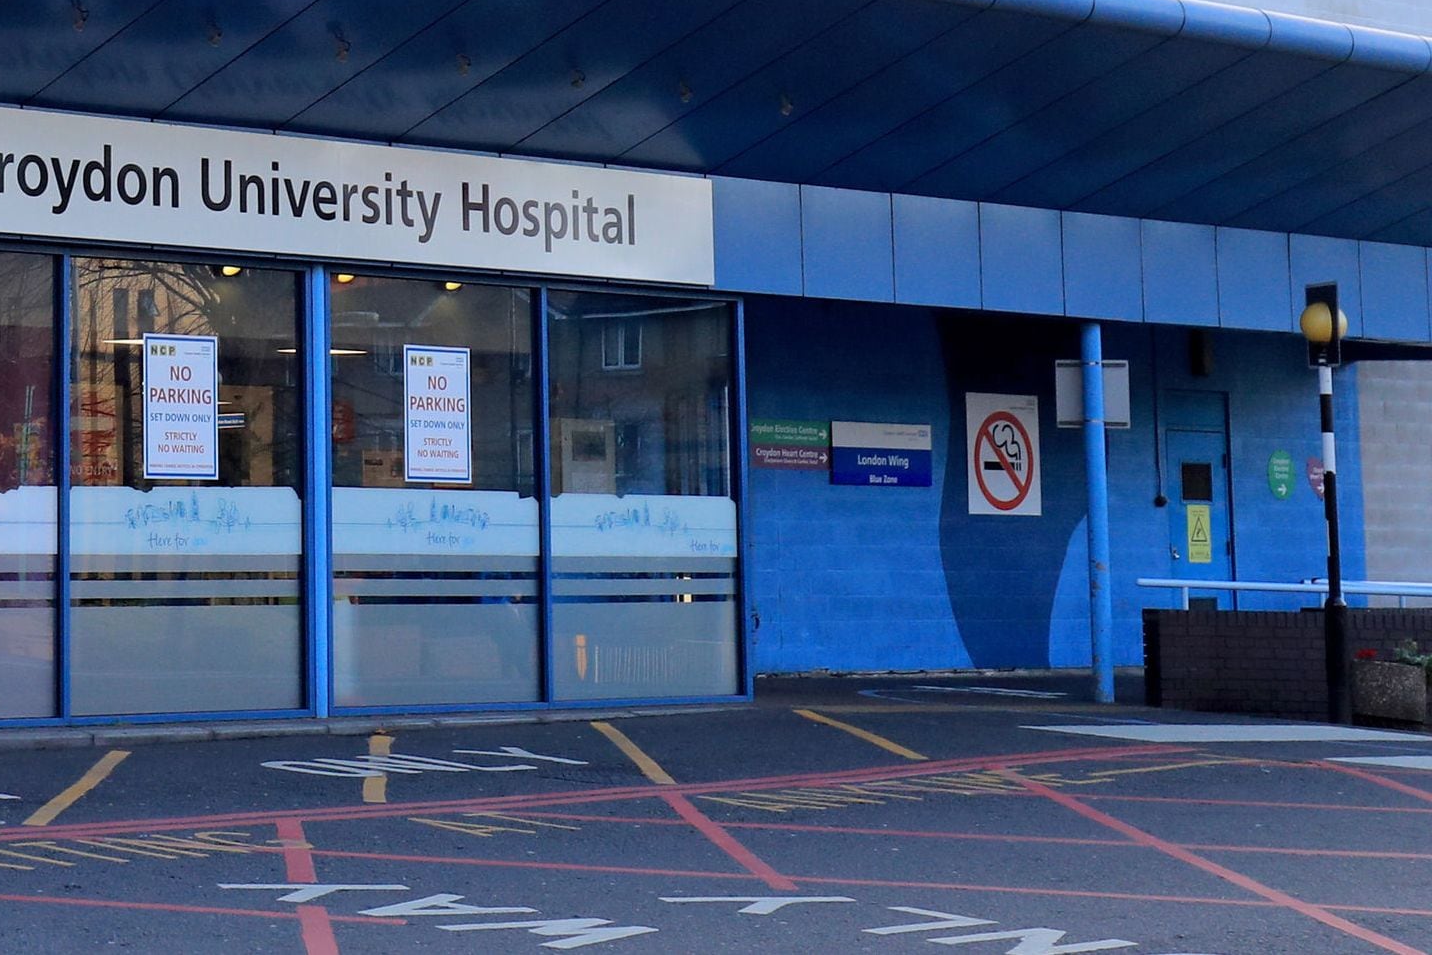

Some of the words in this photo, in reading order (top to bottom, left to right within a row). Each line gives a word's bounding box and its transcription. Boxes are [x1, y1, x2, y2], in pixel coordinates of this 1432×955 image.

[201, 157, 441, 244] University
[461, 181, 636, 252] Hospital
[170, 366, 192, 381] NO
[428, 376, 447, 390] NO
[150, 388, 212, 404] PARKING
[410, 396, 465, 412] PARKING
[150, 413, 163, 422] SET
[165, 413, 190, 422] DOWN
[192, 414, 211, 423] ONLY
[410, 420, 422, 428] SET
[423, 420, 446, 429] DOWN
[448, 421, 465, 430] ONLY
[165, 432, 197, 441] STRICTLY
[424, 438, 452, 446] STRICTLY
[158, 444, 170, 453] NO
[172, 445, 204, 454] WAITING
[417, 450, 428, 458] NO
[430, 450, 459, 459] WAITING
[755, 447, 781, 459] Croydon
[857, 455, 887, 466] London
[888, 456, 909, 469] Wing
[869, 474, 883, 484] Blue
[883, 475, 898, 484] Zone
[148, 532, 172, 548] Here
[173, 533, 190, 550] for
[260, 746, 588, 777] ONLY
[408, 811, 581, 836] AT
[658, 896, 1224, 955] NLY
